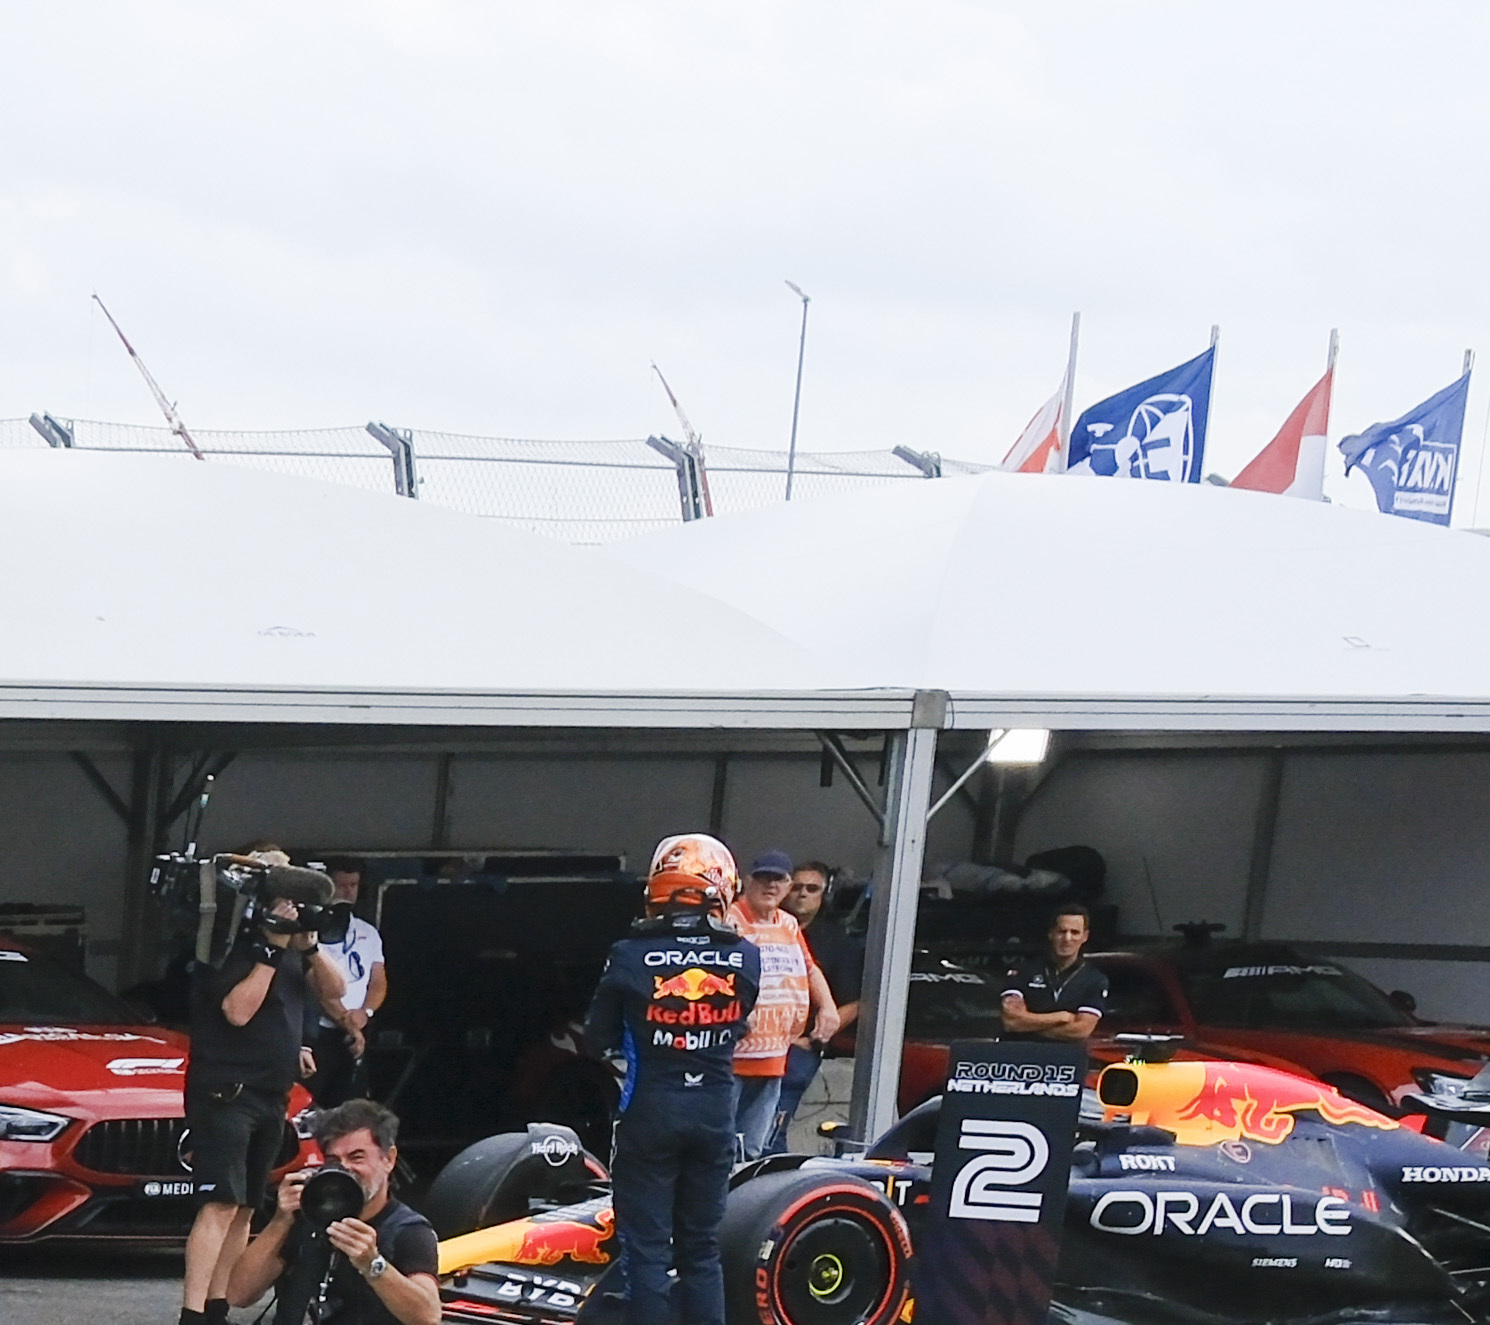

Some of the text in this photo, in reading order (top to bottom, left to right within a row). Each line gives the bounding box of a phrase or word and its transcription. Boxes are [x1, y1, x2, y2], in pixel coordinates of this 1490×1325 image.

[644, 950, 743, 968] ORACLE
[954, 1062, 1077, 1084] ROUND 15
[946, 1077, 1082, 1098] NETHERLANDS
[948, 1118, 1050, 1223] 2
[1090, 1190, 1354, 1237] ORACLE
